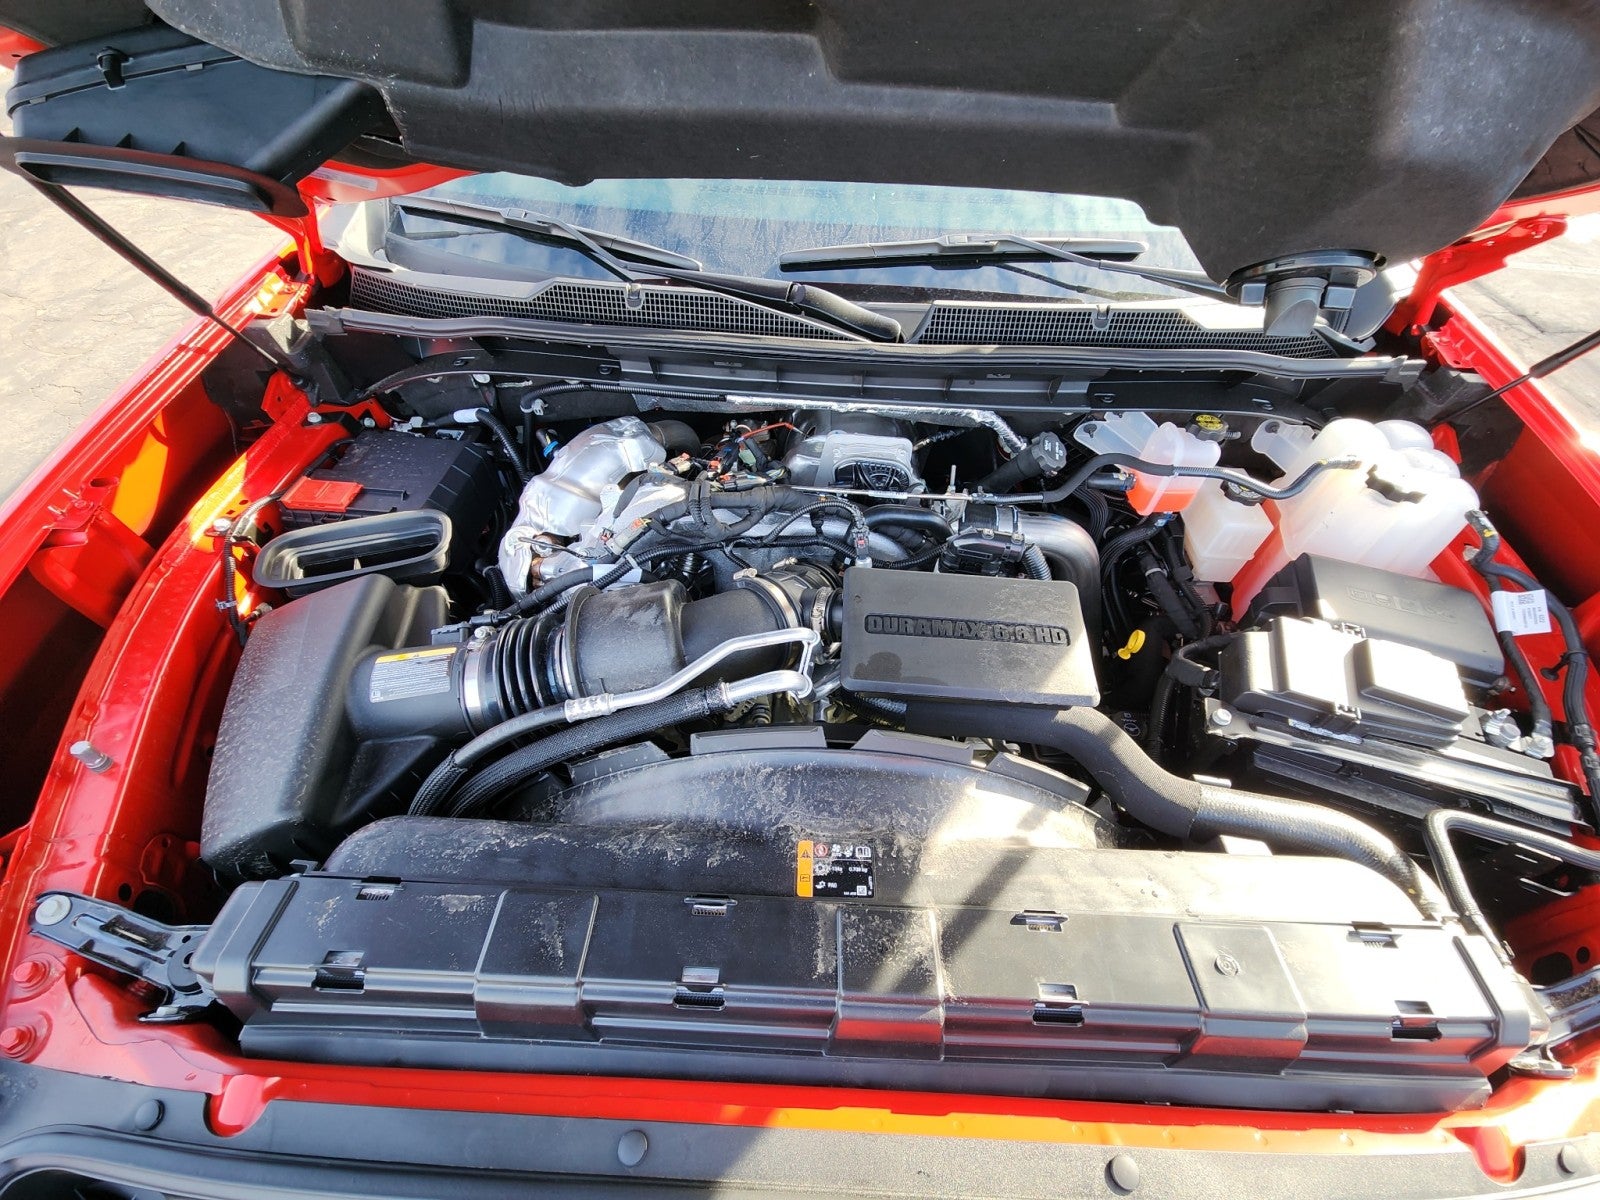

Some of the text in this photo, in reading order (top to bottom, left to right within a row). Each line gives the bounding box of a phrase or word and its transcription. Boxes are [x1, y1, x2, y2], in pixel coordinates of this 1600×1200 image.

[867, 615, 1066, 645] DURAMAX 6.6 HD
